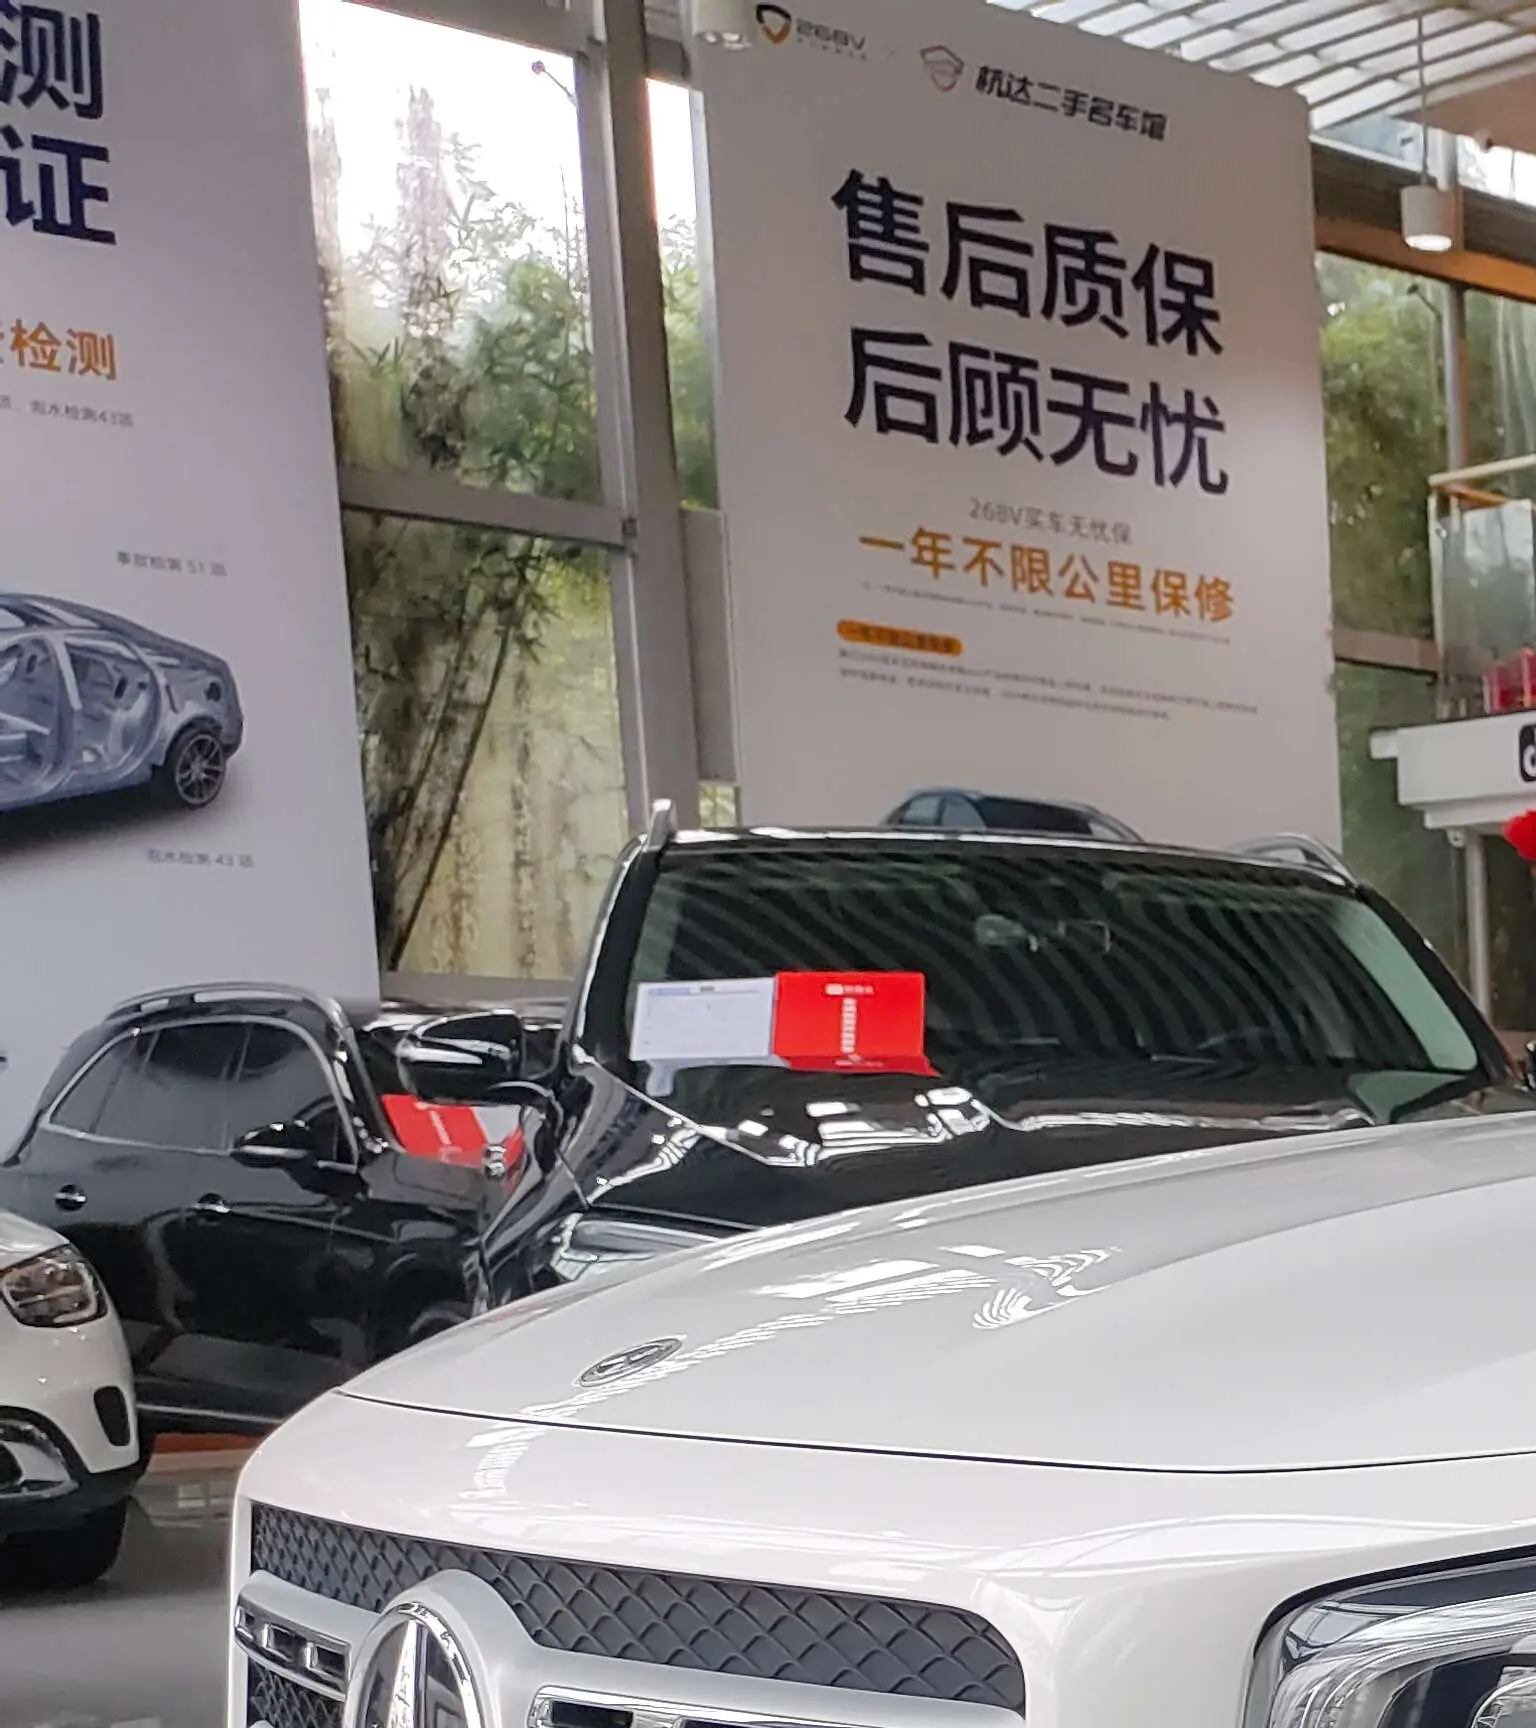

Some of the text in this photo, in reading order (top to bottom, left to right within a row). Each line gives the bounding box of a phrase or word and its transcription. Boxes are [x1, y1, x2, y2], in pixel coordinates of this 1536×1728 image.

[975, 65, 1168, 141] 杭达二手名车馆
[831, 169, 1223, 357] 售后质保
[0, 318, 117, 381] 检测
[844, 327, 1229, 496] 后顾无忧
[968, 499, 1133, 546] 268V买车无忧保
[859, 527, 1235, 622] 一年不限公里保修
